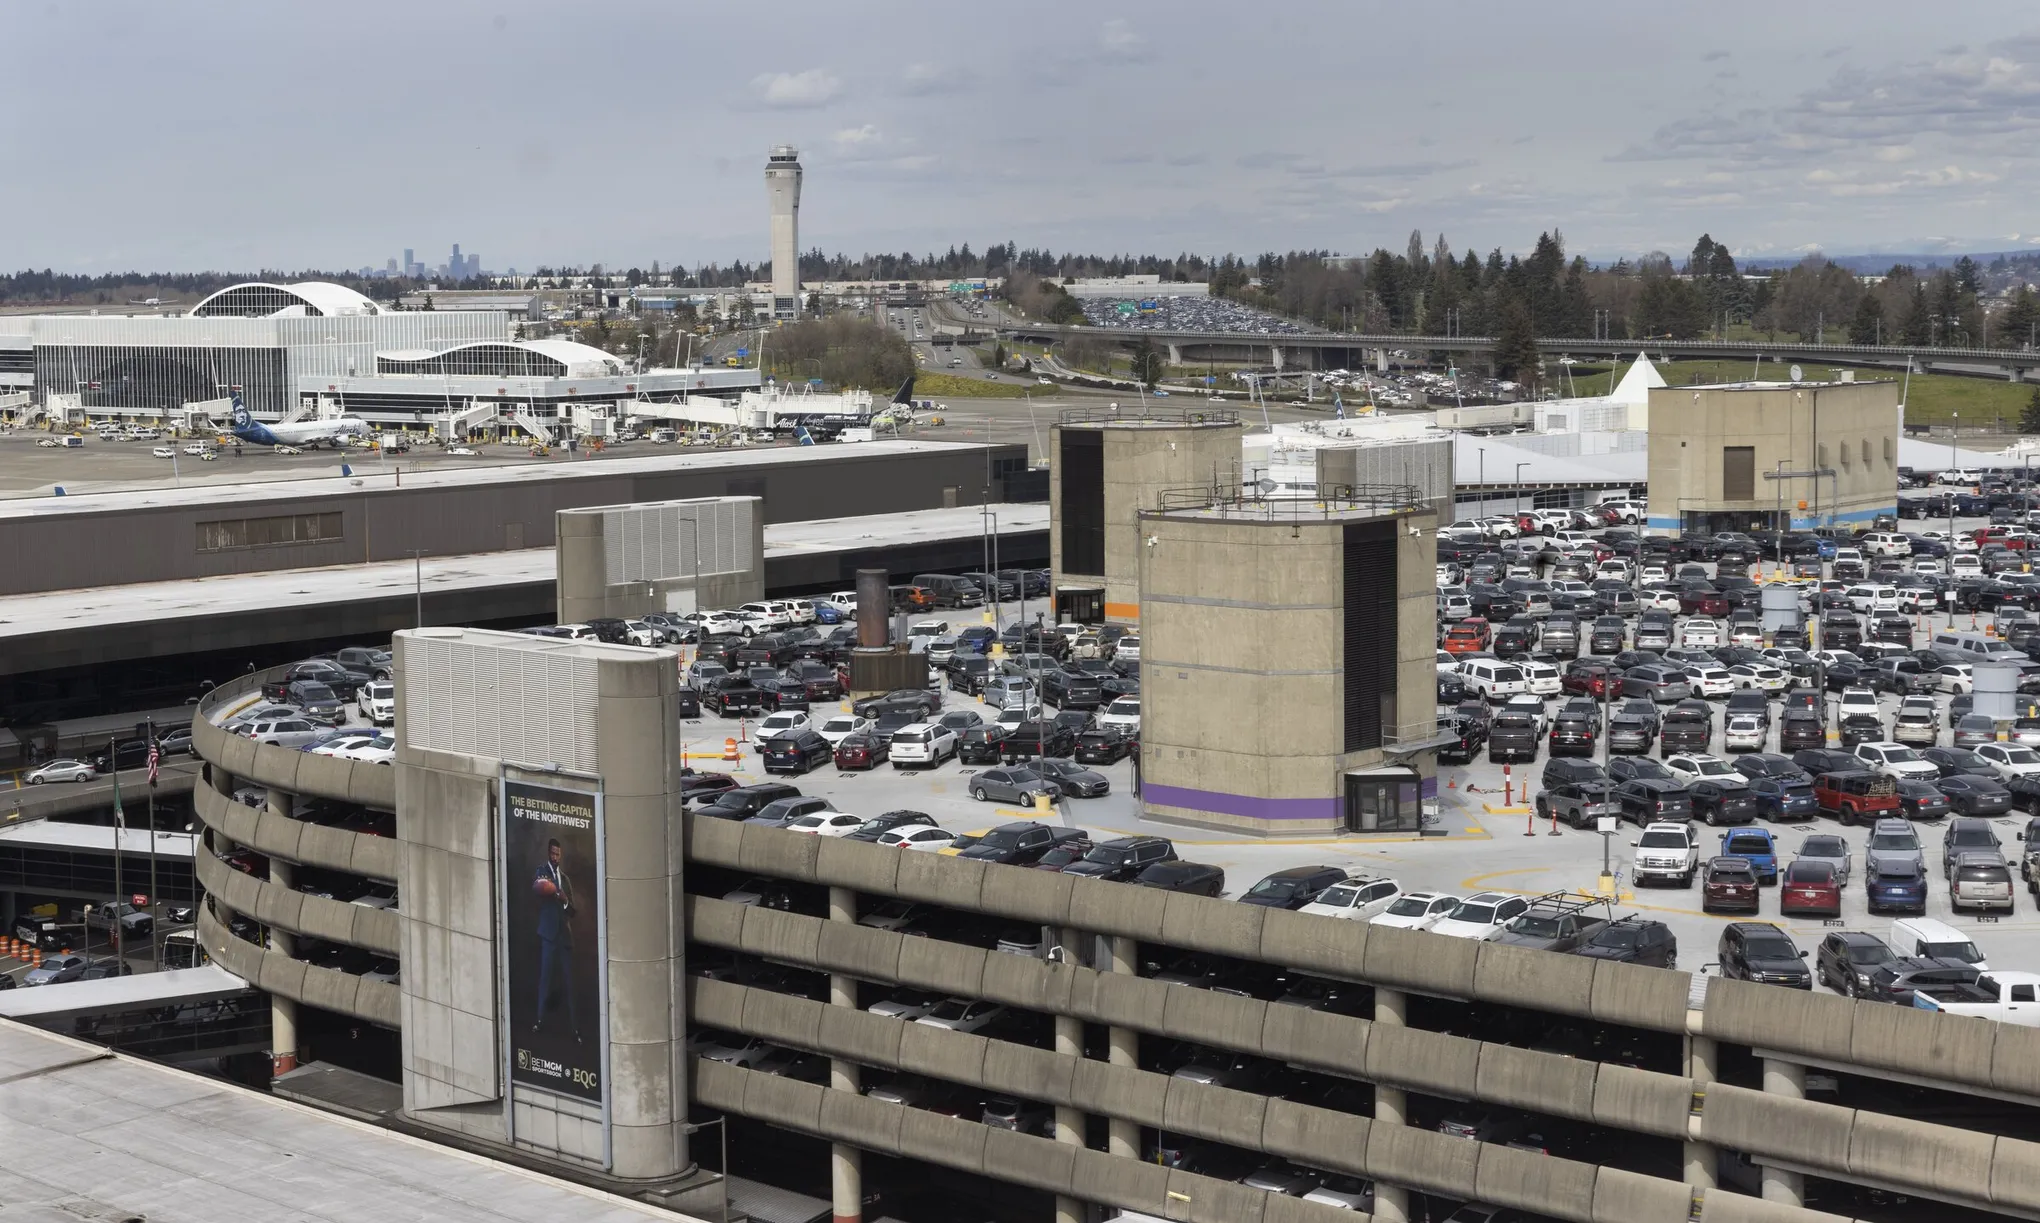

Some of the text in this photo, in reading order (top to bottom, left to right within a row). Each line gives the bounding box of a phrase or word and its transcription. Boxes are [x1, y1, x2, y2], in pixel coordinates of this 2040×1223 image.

[510, 796, 592, 817] THE BETTING CAPITAL
[513, 808, 590, 829] OF THE NORTHWEST
[351, 1030, 357, 1039] 3
[531, 1057, 562, 1072] BETMGM
[573, 1068, 597, 1089] EQC
